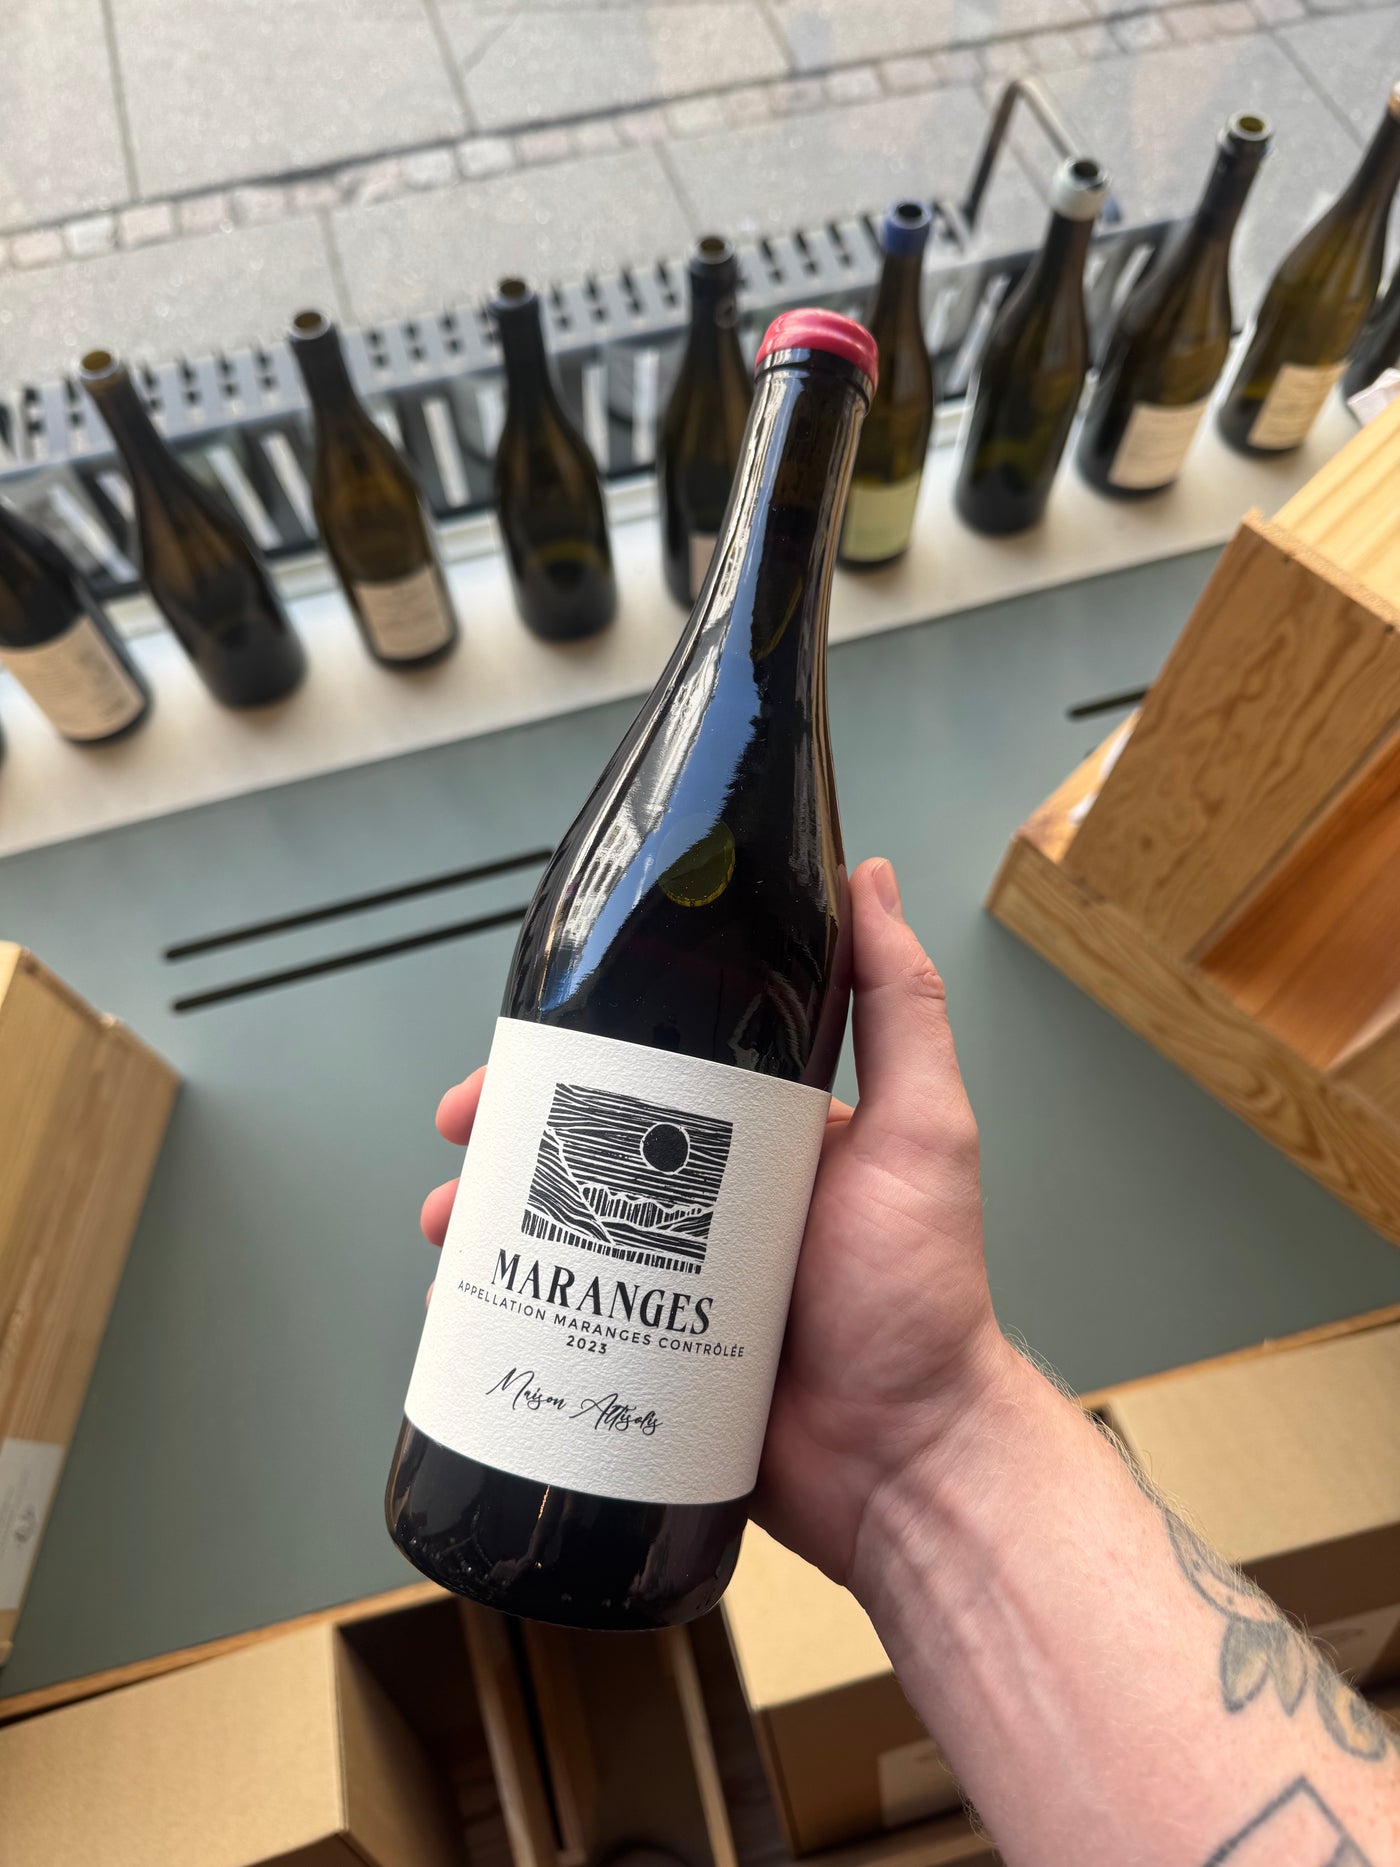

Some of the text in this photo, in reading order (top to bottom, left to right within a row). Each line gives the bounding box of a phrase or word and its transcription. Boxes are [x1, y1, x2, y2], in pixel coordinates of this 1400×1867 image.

[458, 1280, 745, 1358] APPELLATION MARANGES CONTRÔLÉE
[491, 1249, 714, 1335] MARANGES
[566, 1336, 608, 1355] 2023
[486, 1367, 567, 1411] Maison
